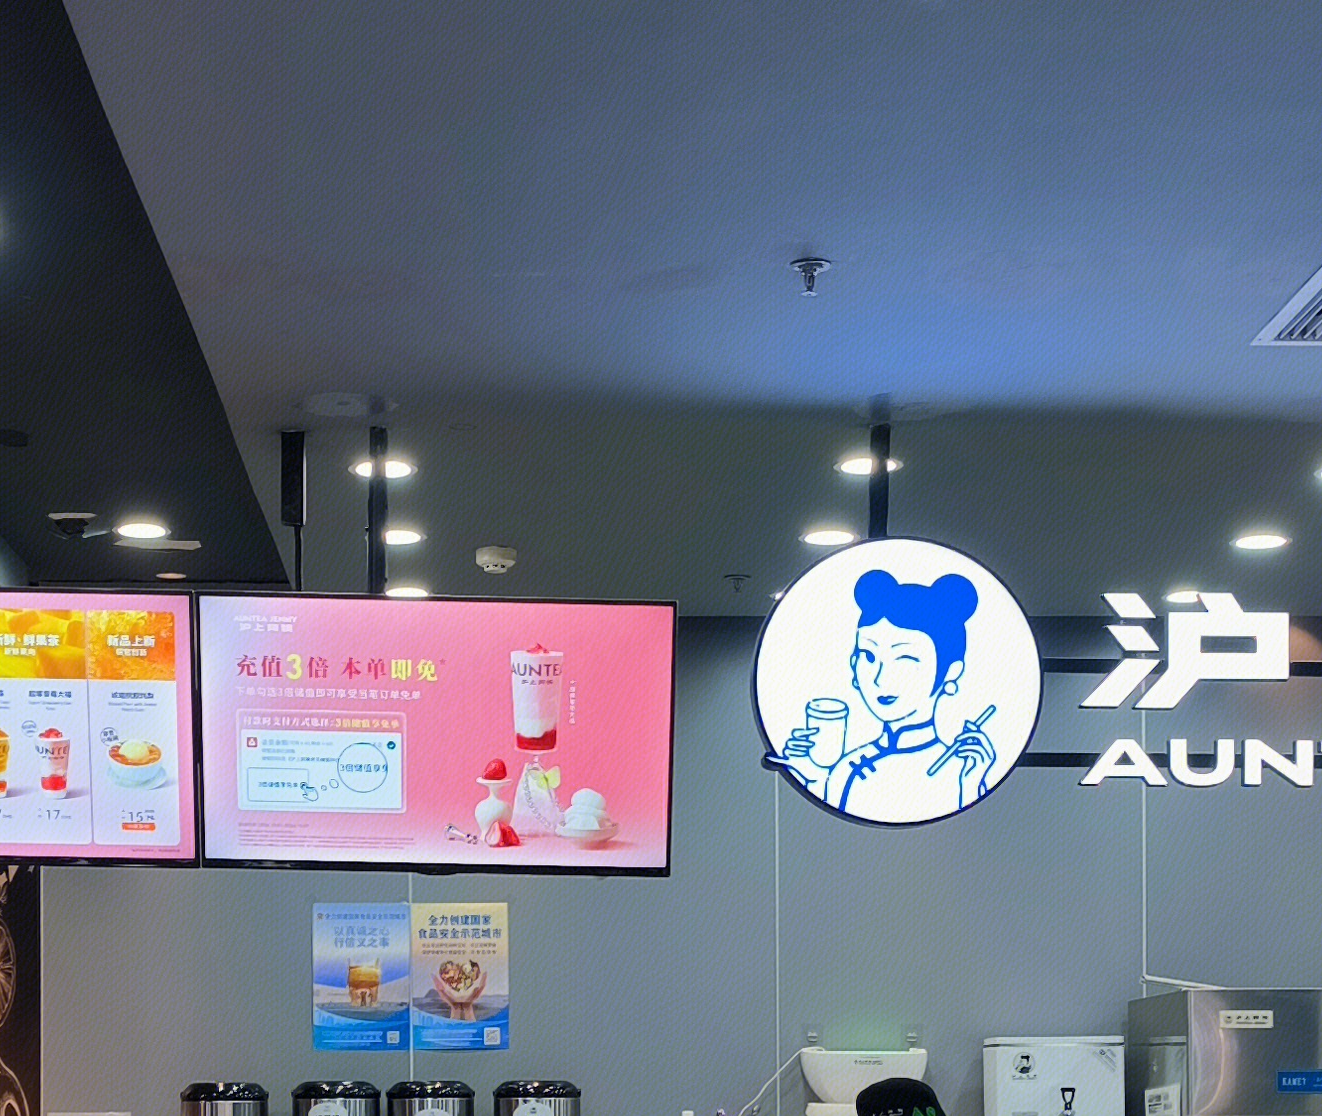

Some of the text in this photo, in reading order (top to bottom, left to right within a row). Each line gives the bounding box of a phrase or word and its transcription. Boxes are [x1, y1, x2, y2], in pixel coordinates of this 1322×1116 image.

[236, 653, 438, 682] 充值3倍 本单即免
[427, 914, 492, 926] 全力创建国家
[417, 927, 502, 939] 食品安全示范城市
